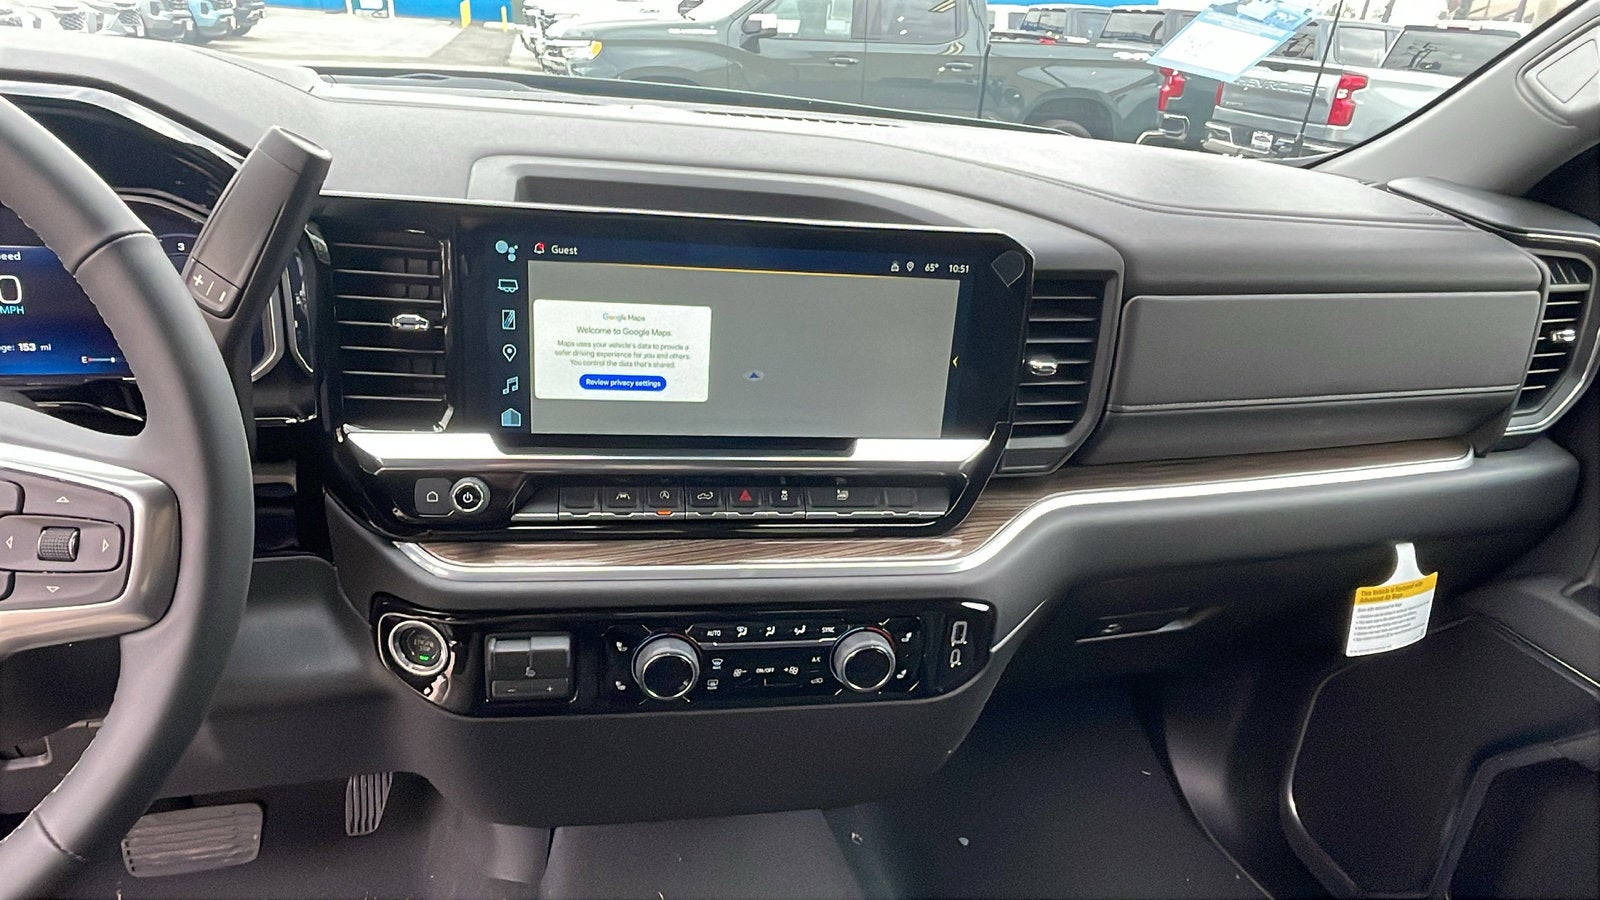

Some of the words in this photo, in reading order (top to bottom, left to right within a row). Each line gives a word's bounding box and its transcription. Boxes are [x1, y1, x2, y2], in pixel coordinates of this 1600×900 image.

[178, 242, 185, 251] 3
[551, 245, 578, 255] Guest
[0, 251, 22, 261] eed
[925, 263, 939, 272] 65°
[949, 264, 969, 274] 10:51
[0, 275, 22, 304] 0
[0, 305, 25, 315] MPH
[602, 312, 627, 322] Google
[628, 314, 646, 322] Maps
[576, 326, 611, 335] Welcome
[622, 327, 649, 338] Google
[0, 344, 15, 354] ge:
[18, 342, 37, 352] 153
[40, 344, 51, 352] mi
[557, 340, 575, 348] Maps
[593, 342, 607, 350] your
[653, 343, 660, 351] to
[660, 343, 684, 351] provide
[572, 349, 595, 359] driving
[596, 351, 632, 359] experience
[633, 351, 642, 359] for
[656, 352, 668, 360] and
[82, 356, 88, 364] E
[585, 378, 609, 386] Review
[610, 379, 634, 389] privacy
[635, 380, 661, 389] settings
[707, 629, 722, 637] AUTO
[821, 626, 836, 634] SYNC
